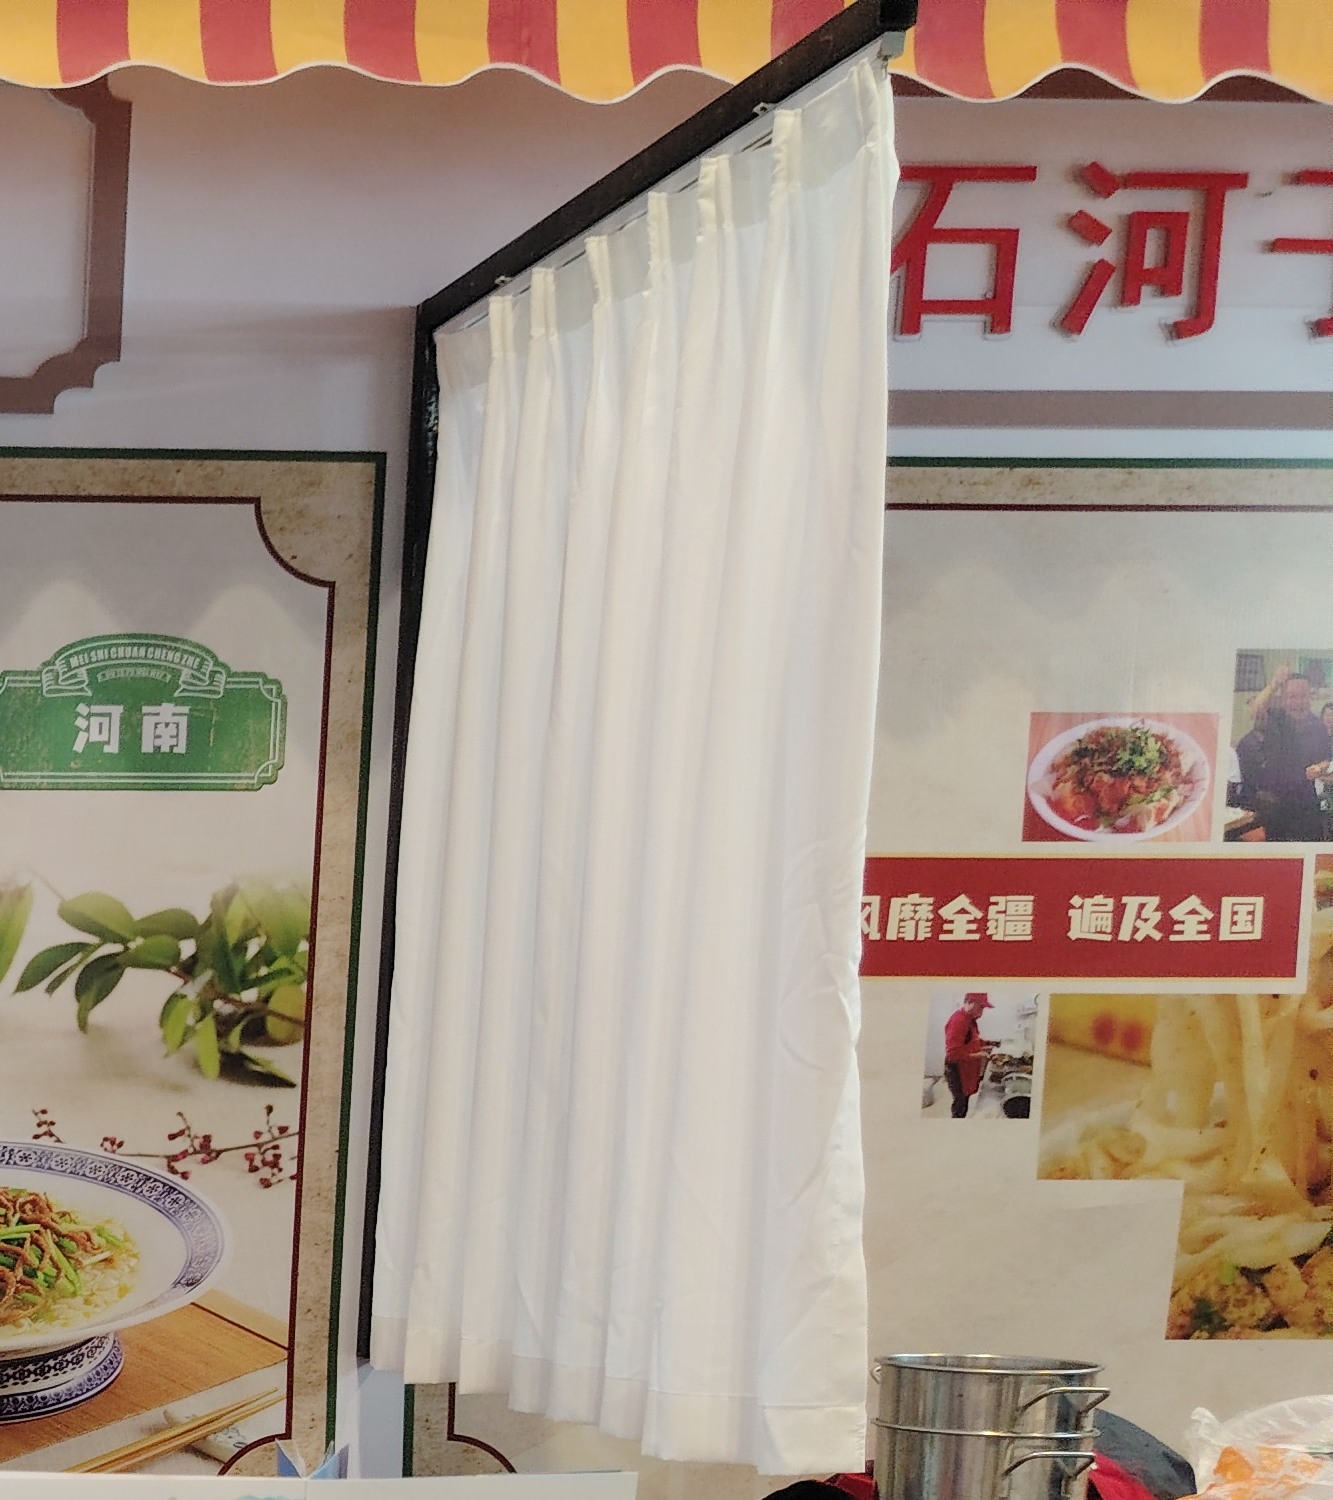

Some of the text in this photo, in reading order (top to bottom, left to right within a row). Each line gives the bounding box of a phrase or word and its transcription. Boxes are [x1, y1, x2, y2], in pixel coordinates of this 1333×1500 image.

[72, 702, 190, 754] 河南
[1067, 893, 1264, 943] 遍及全国
